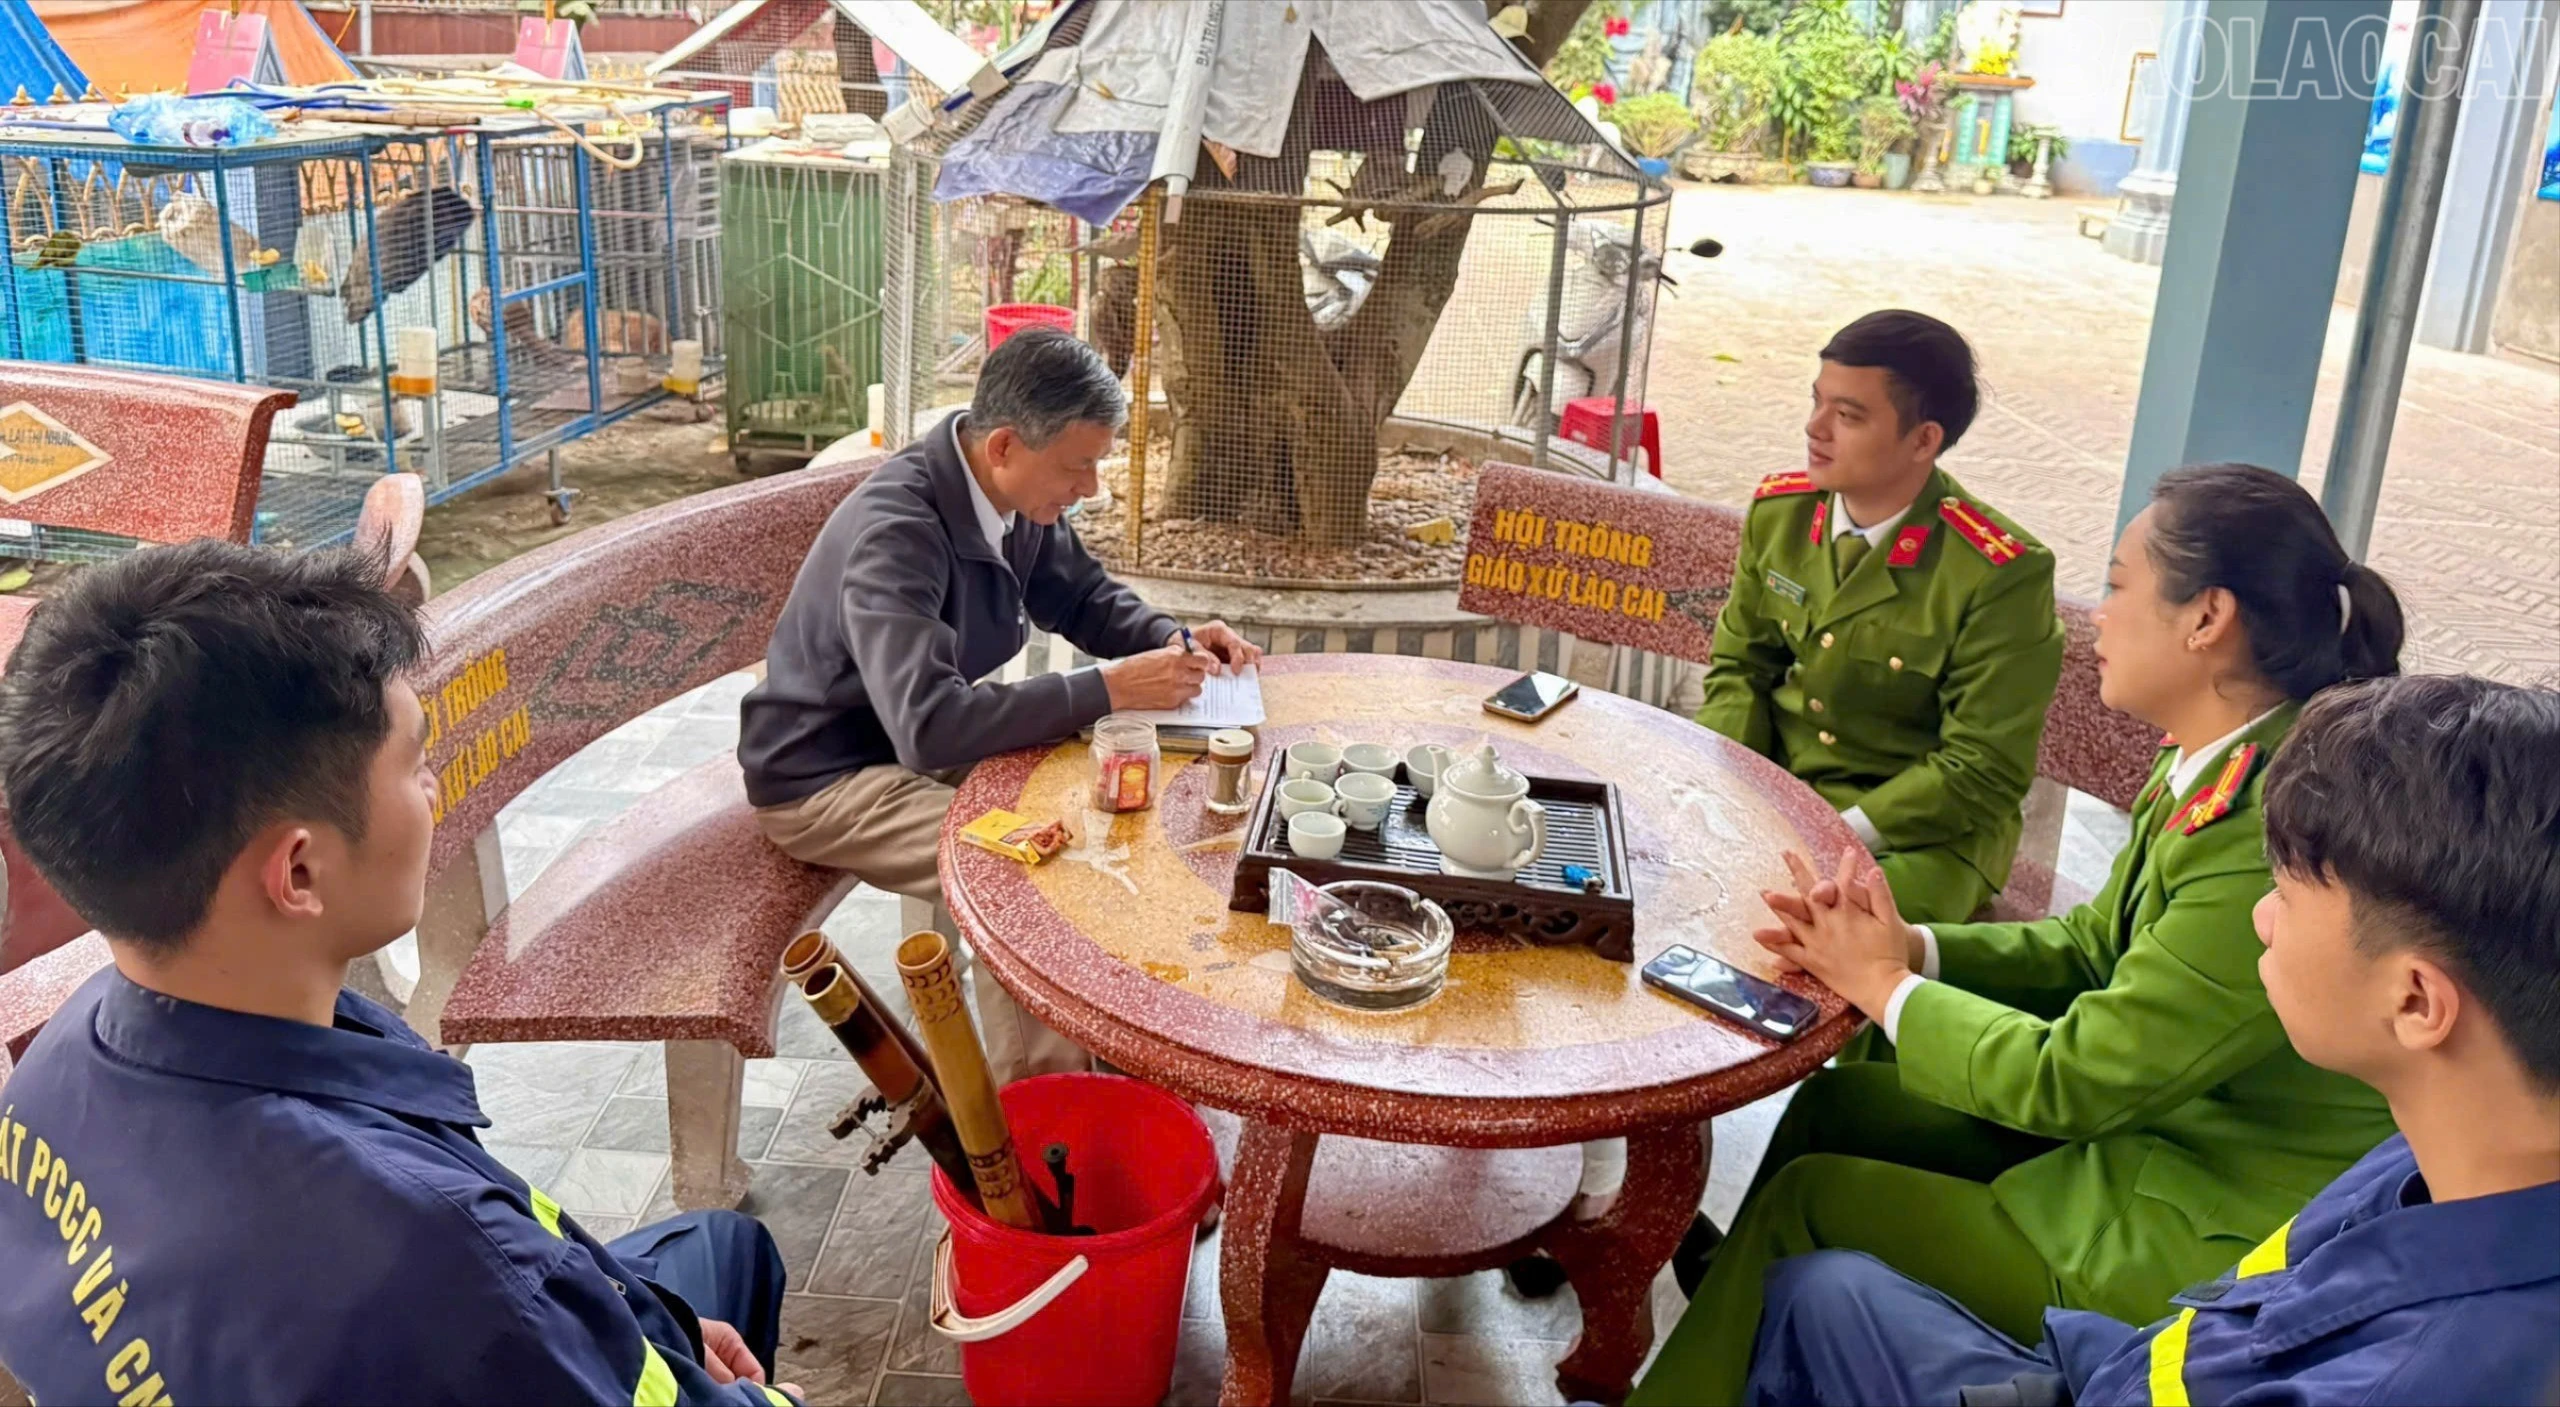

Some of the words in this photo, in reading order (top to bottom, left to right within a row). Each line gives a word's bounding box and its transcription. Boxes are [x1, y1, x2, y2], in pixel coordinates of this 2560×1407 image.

[1495, 508, 1545, 549] HỘI
[1468, 552, 1526, 594] GIÁO
[1527, 560, 1569, 599] XỨ
[1569, 571, 1617, 611] LÀO
[1623, 584, 1667, 623] CAI
[501, 703, 531, 760] CAI
[26, 1137, 102, 1265] PCCC
[72, 1245, 129, 1345] VÀ
